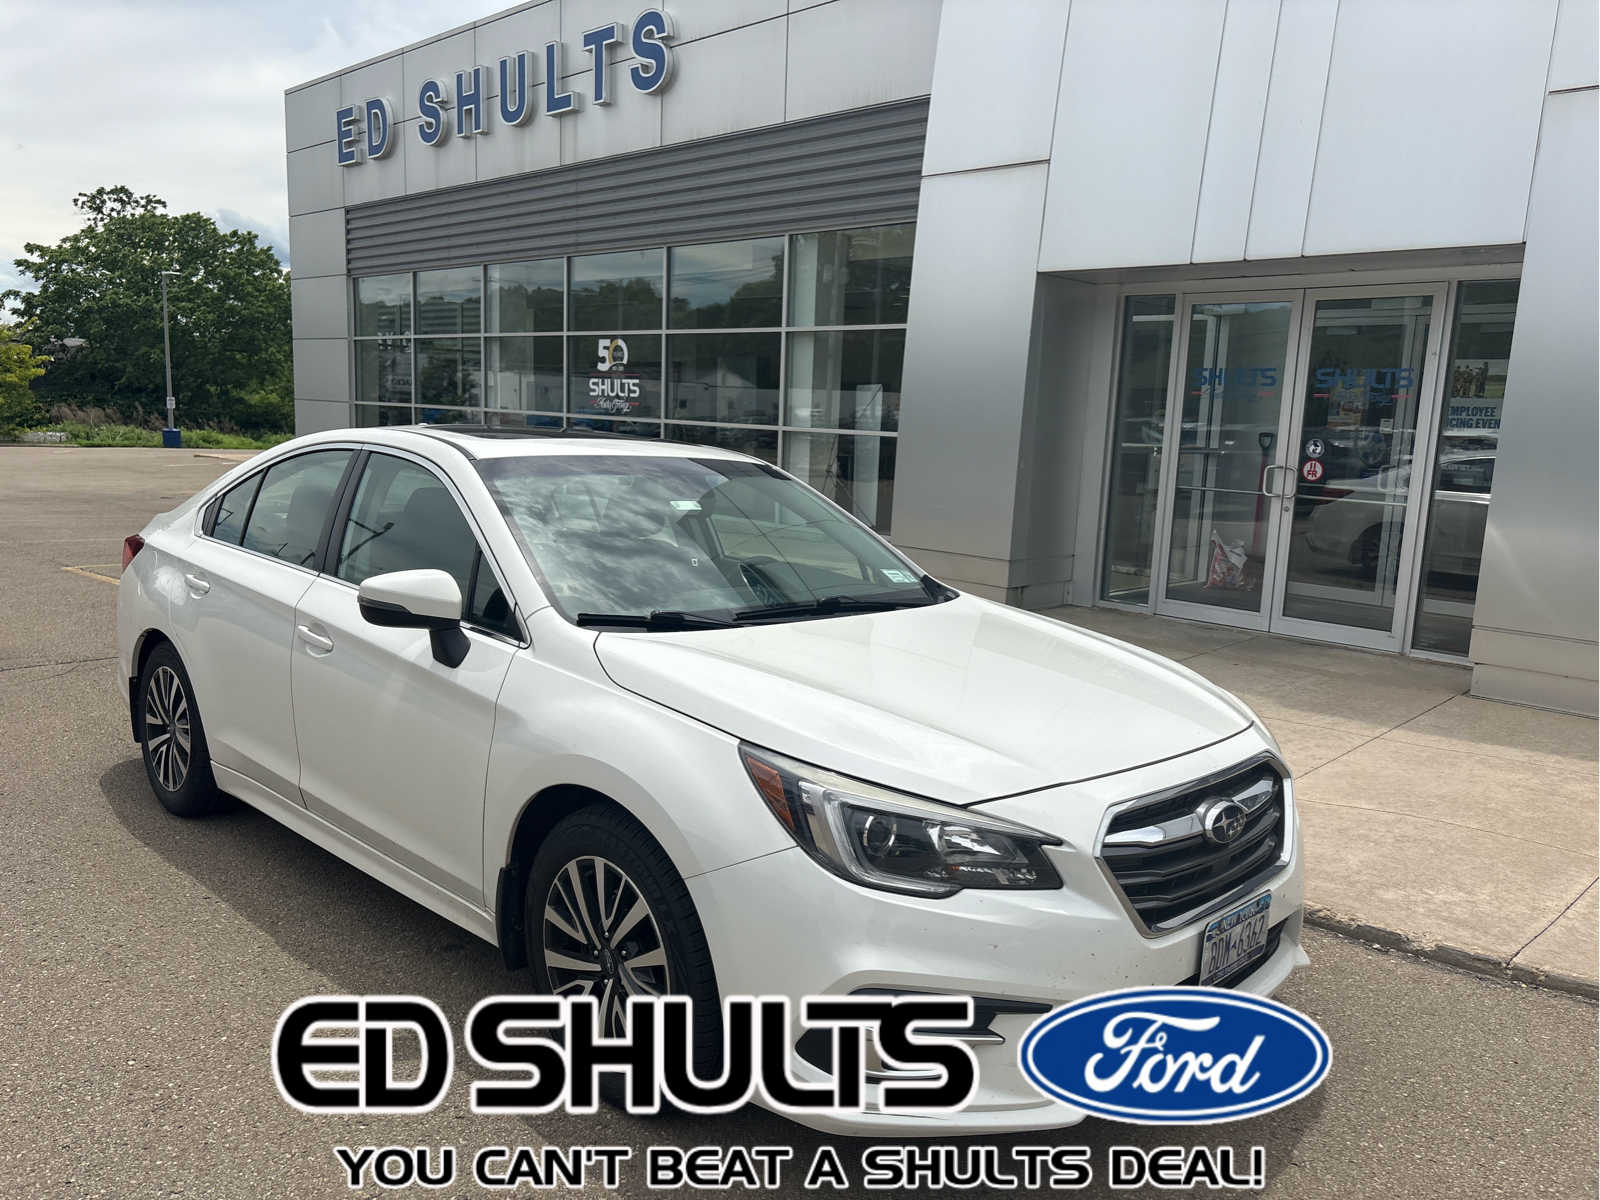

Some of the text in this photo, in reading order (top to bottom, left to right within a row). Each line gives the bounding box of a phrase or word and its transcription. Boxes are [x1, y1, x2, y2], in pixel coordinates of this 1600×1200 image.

[336, 8, 674, 166] ED SHULTS
[597, 338, 629, 372] 50
[589, 378, 641, 397] SHULTS
[1447, 417, 1473, 428] CING
